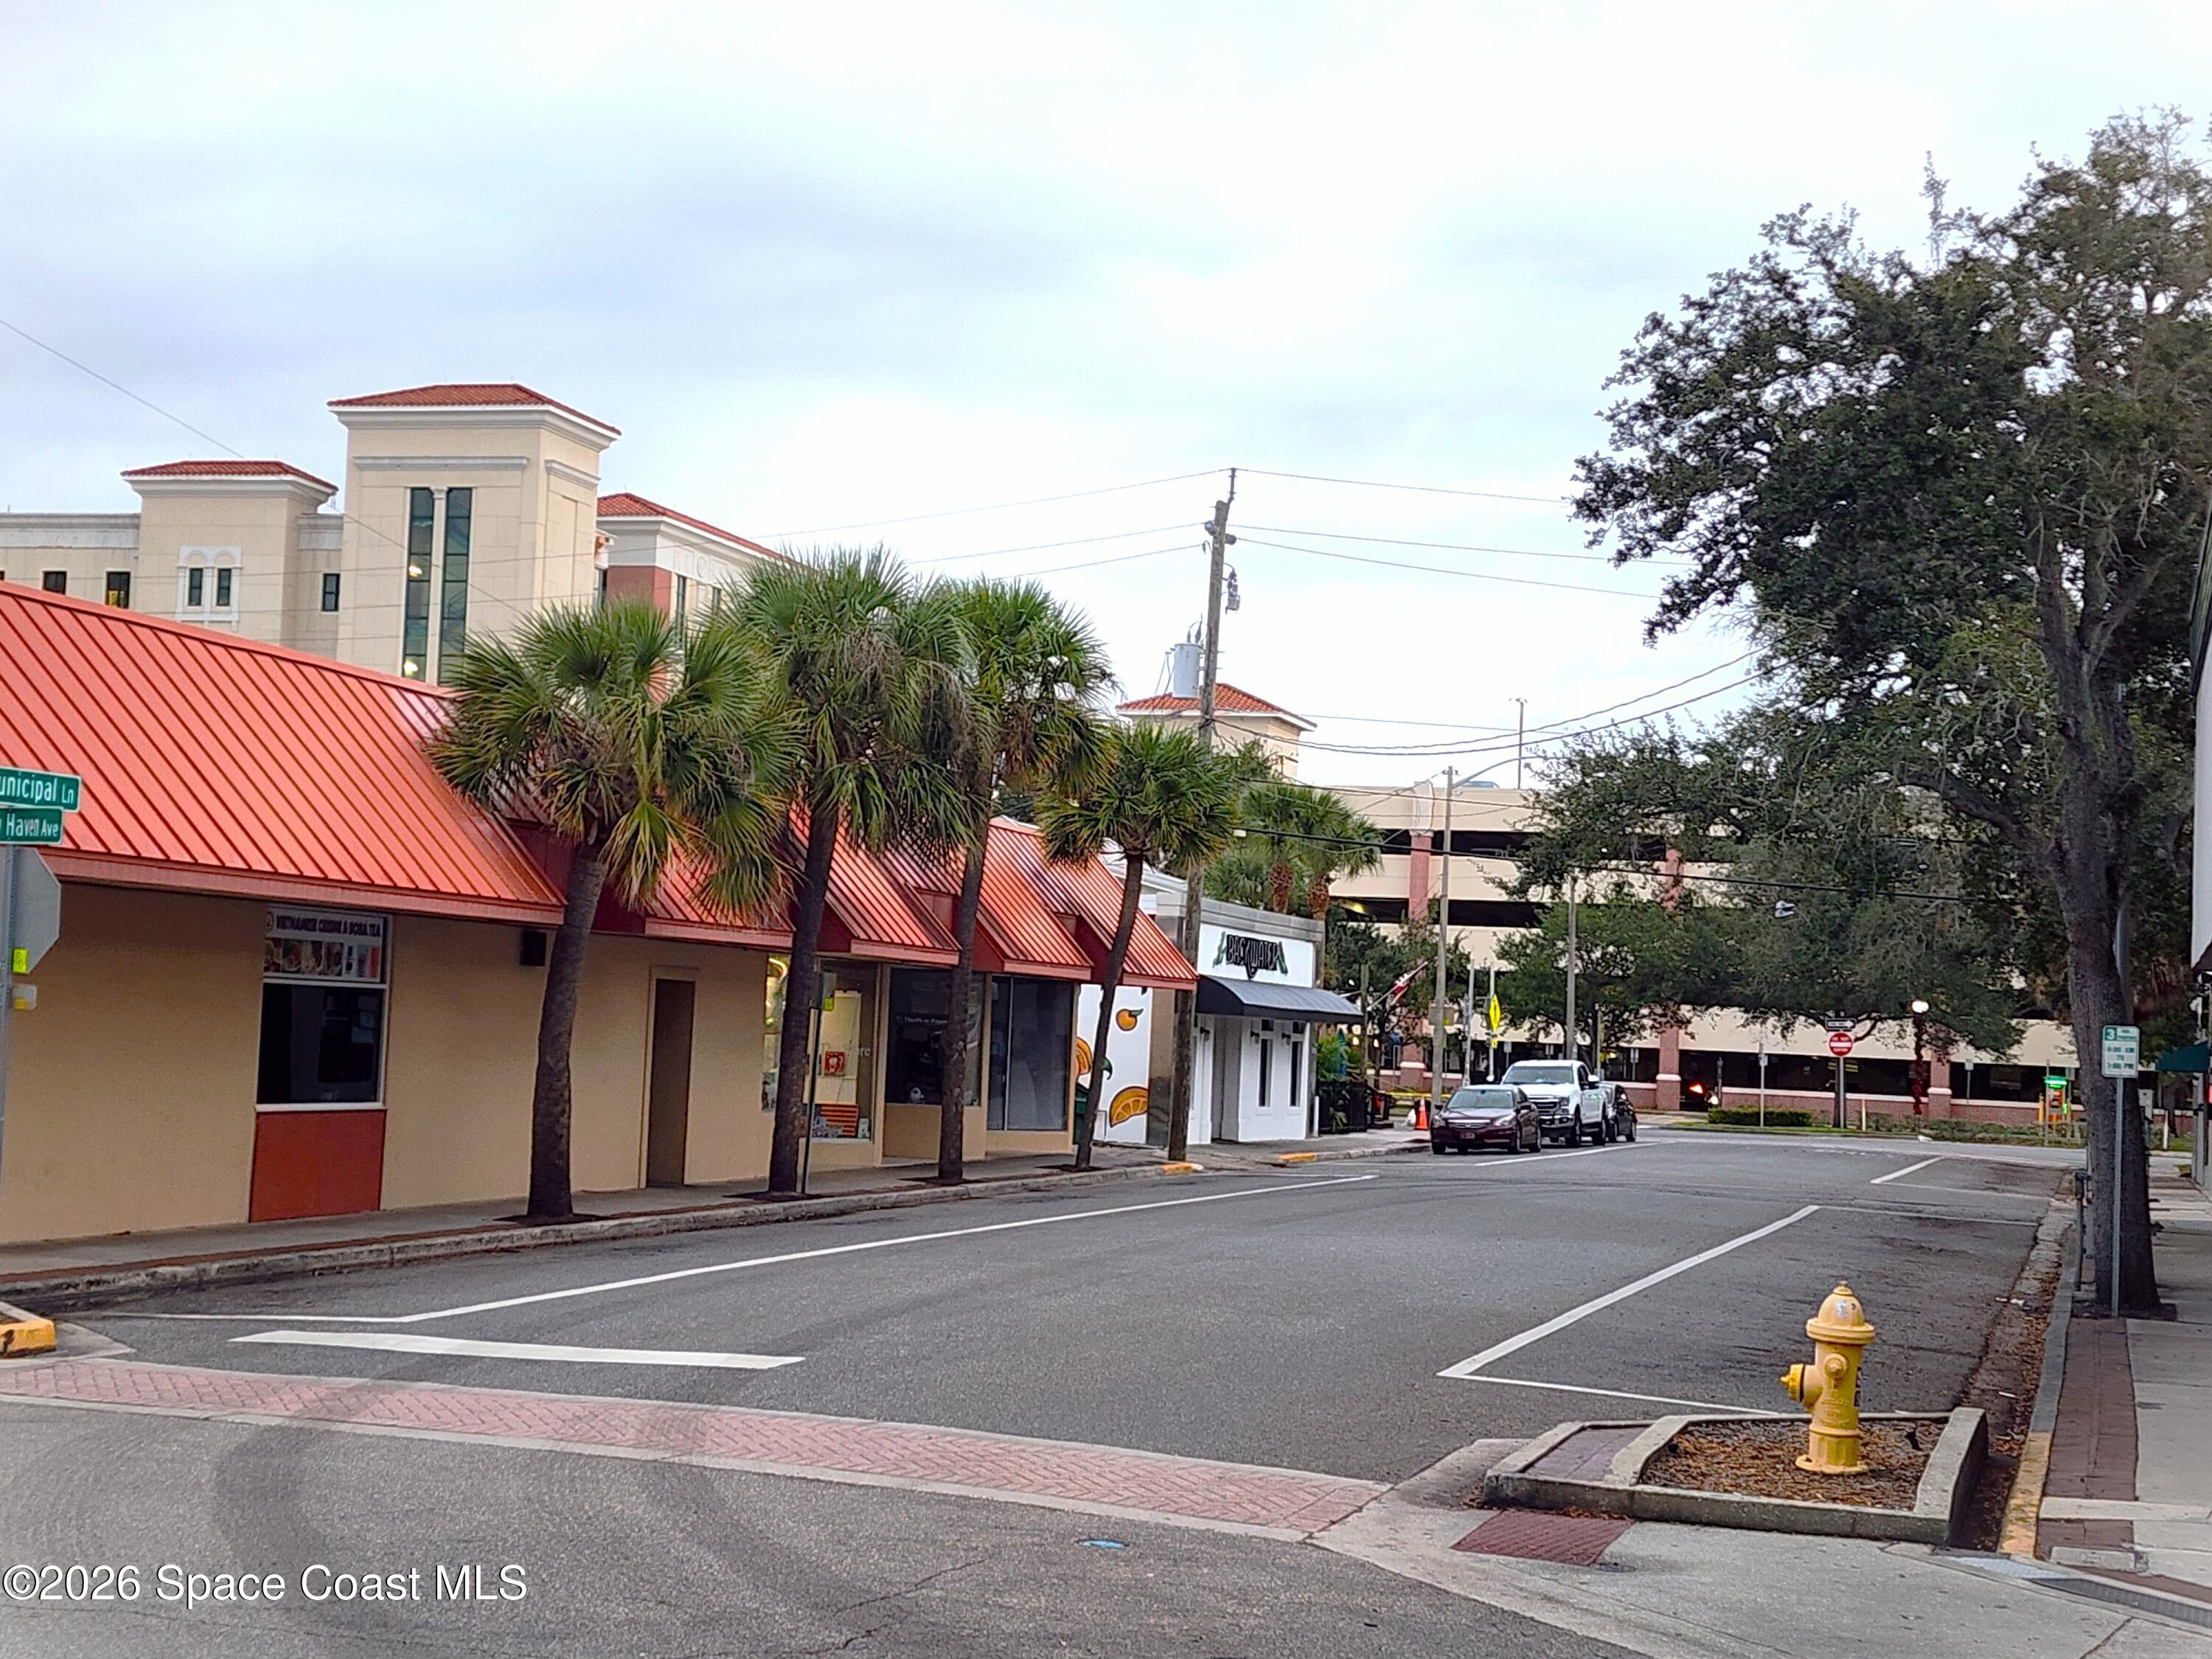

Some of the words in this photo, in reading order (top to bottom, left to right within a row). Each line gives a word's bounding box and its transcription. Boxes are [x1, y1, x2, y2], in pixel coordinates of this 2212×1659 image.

[61, 783, 74, 804] Ln
[6, 813, 40, 837] Haven
[41, 818, 59, 838] Ave
[2107, 1029, 2115, 1039] 3
